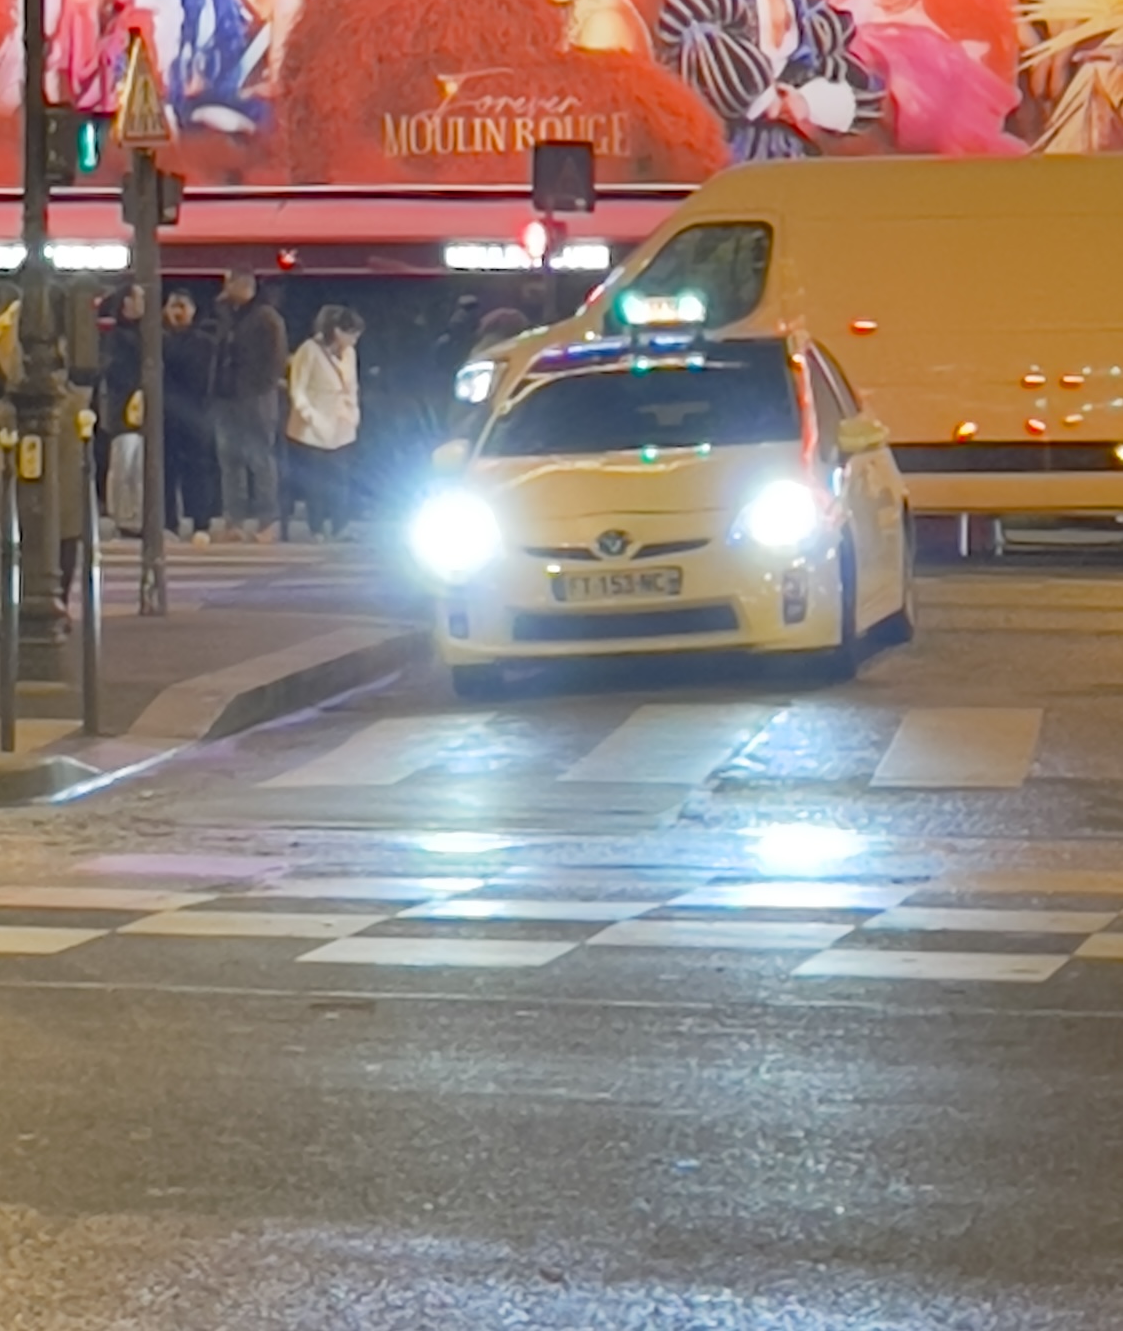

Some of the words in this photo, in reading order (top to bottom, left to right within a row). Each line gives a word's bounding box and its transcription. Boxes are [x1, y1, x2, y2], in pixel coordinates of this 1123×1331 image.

[413, 67, 581, 122] Forever
[384, 113, 509, 157] MOULIN
[512, 112, 631, 157] ROUGE
